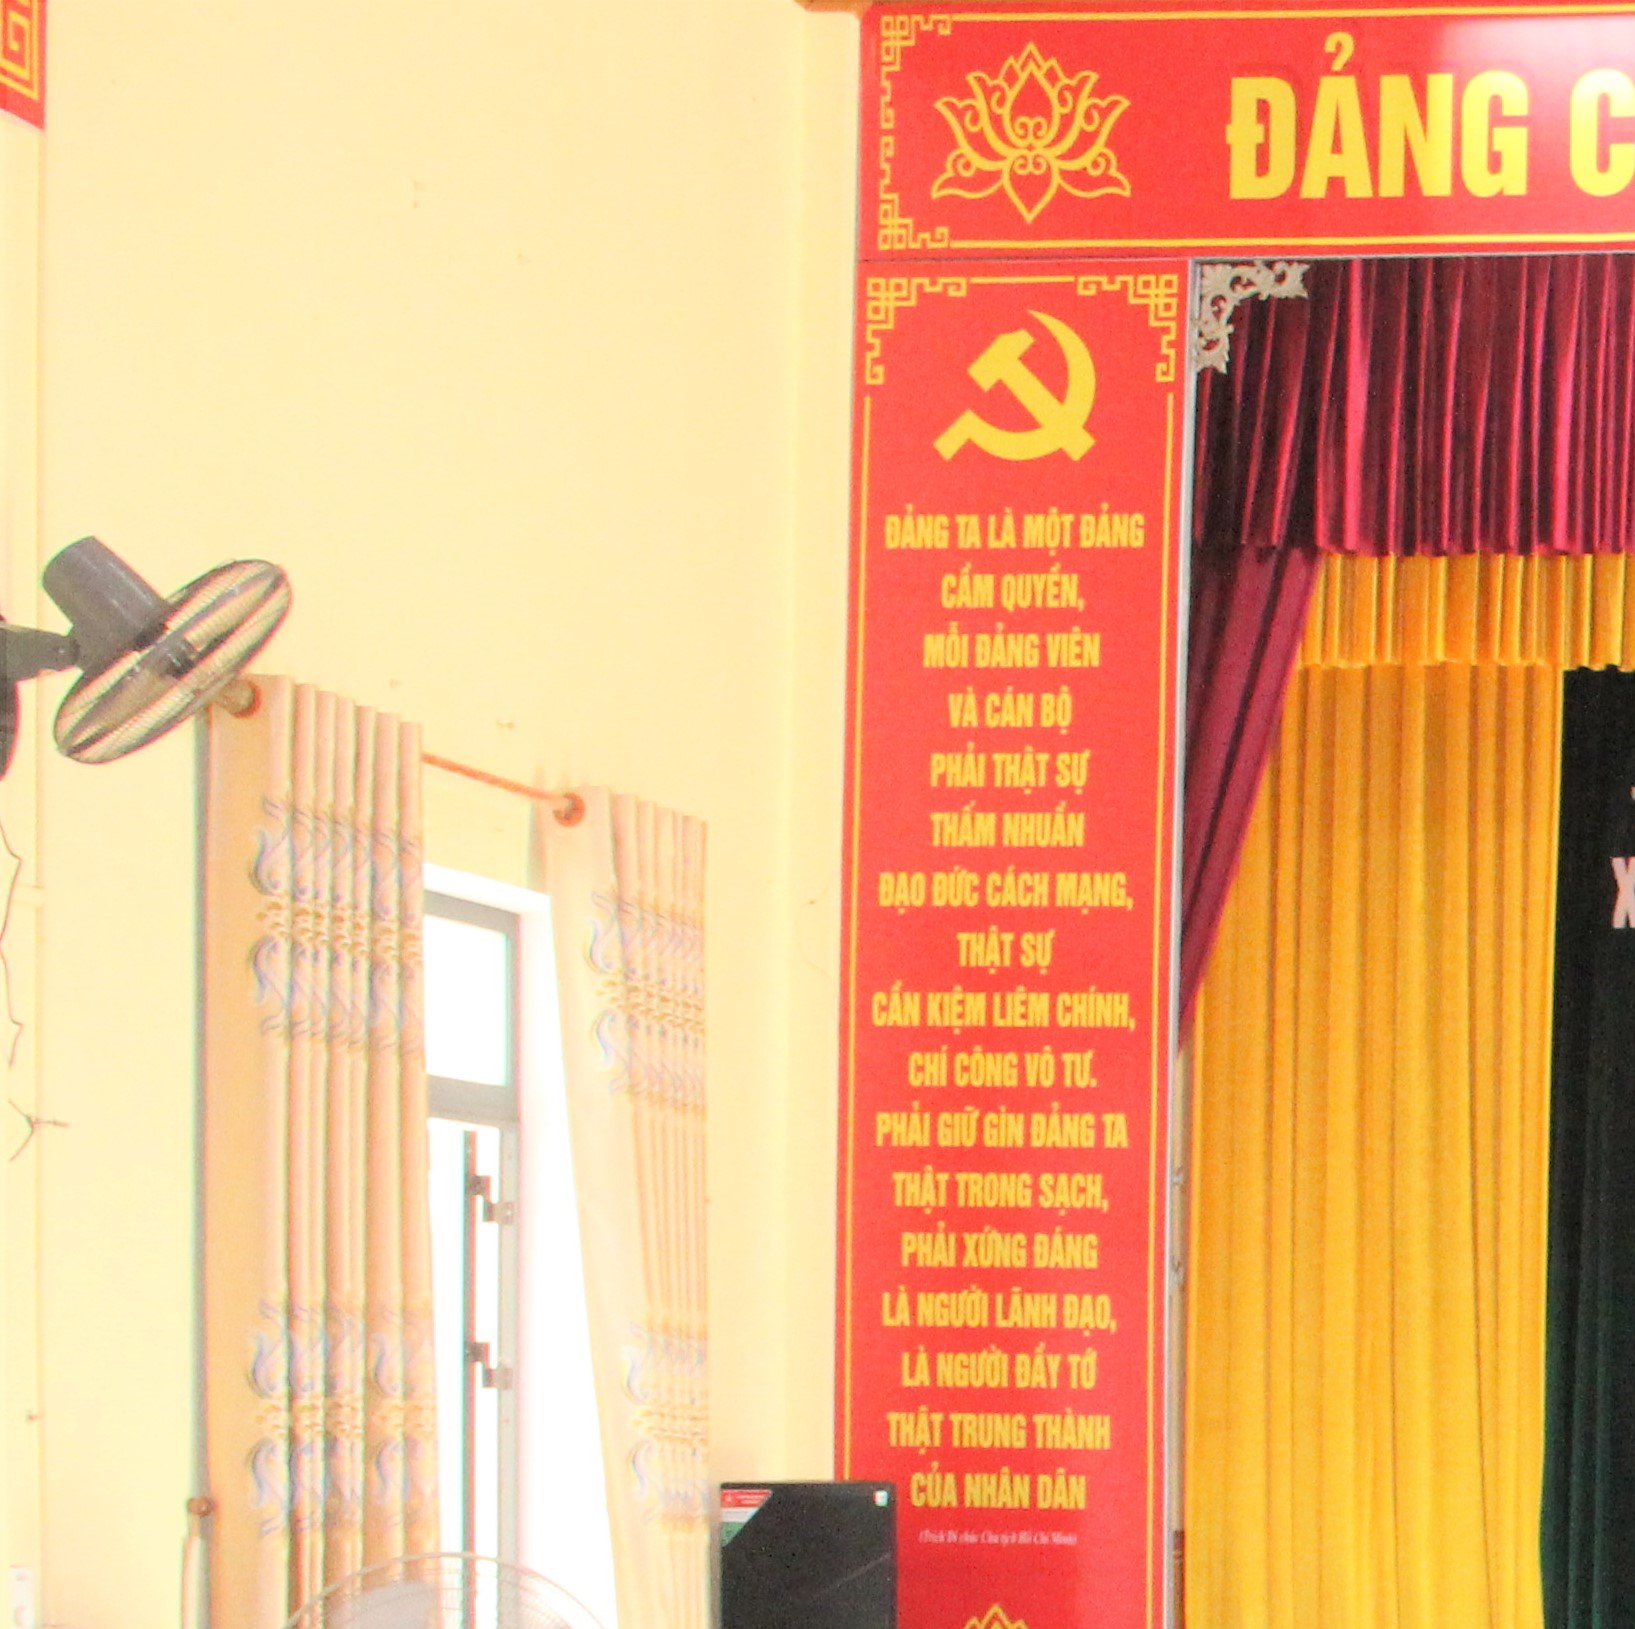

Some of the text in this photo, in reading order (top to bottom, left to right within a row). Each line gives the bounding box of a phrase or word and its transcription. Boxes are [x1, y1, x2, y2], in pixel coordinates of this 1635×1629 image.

[1225, 32, 1529, 198] ĐẢNG
[885, 503, 1144, 555] ĐẢNG TA LÀ MỘT ĐẢNG
[923, 622, 1100, 667] MỖI ĐẢNG VIÊN
[949, 686, 1072, 734] VÀ CÁN BỘ
[931, 742, 1090, 794] PHẢI THẬT SỰ
[879, 866, 1133, 914] ĐẠO ĐỨC CÁCH MẠNG,
[957, 926, 1054, 974] THẬT SỰ
[927, 986, 986, 1033] KIỆM
[993, 986, 1049, 1026] LIÊM
[1056, 986, 1135, 1030] CHÍNH,
[909, 1046, 947, 1086] CHÍ
[955, 1046, 1018, 1086] CÔNG
[1025, 1046, 1055, 1087] VÔ
[876, 1101, 1128, 1148] PHẢI GIỮ GÌN ĐẢNG TA
[893, 1165, 1108, 1215] THẬT TRONG SẠCH,
[902, 1222, 1098, 1269] PHẢI XỨNG ĐÁNG
[883, 1286, 1116, 1336] LÀ NGƯỜI LÃNH ĐẠO,
[902, 1346, 930, 1386] LÀ
[937, 1346, 1008, 1387] NGƯỜI
[1068, 1348, 1097, 1389] TỚ
[888, 1406, 1111, 1453] THẬT TRUNG THÀNH
[912, 1462, 1086, 1509] CỦA NHÂN DÂN
